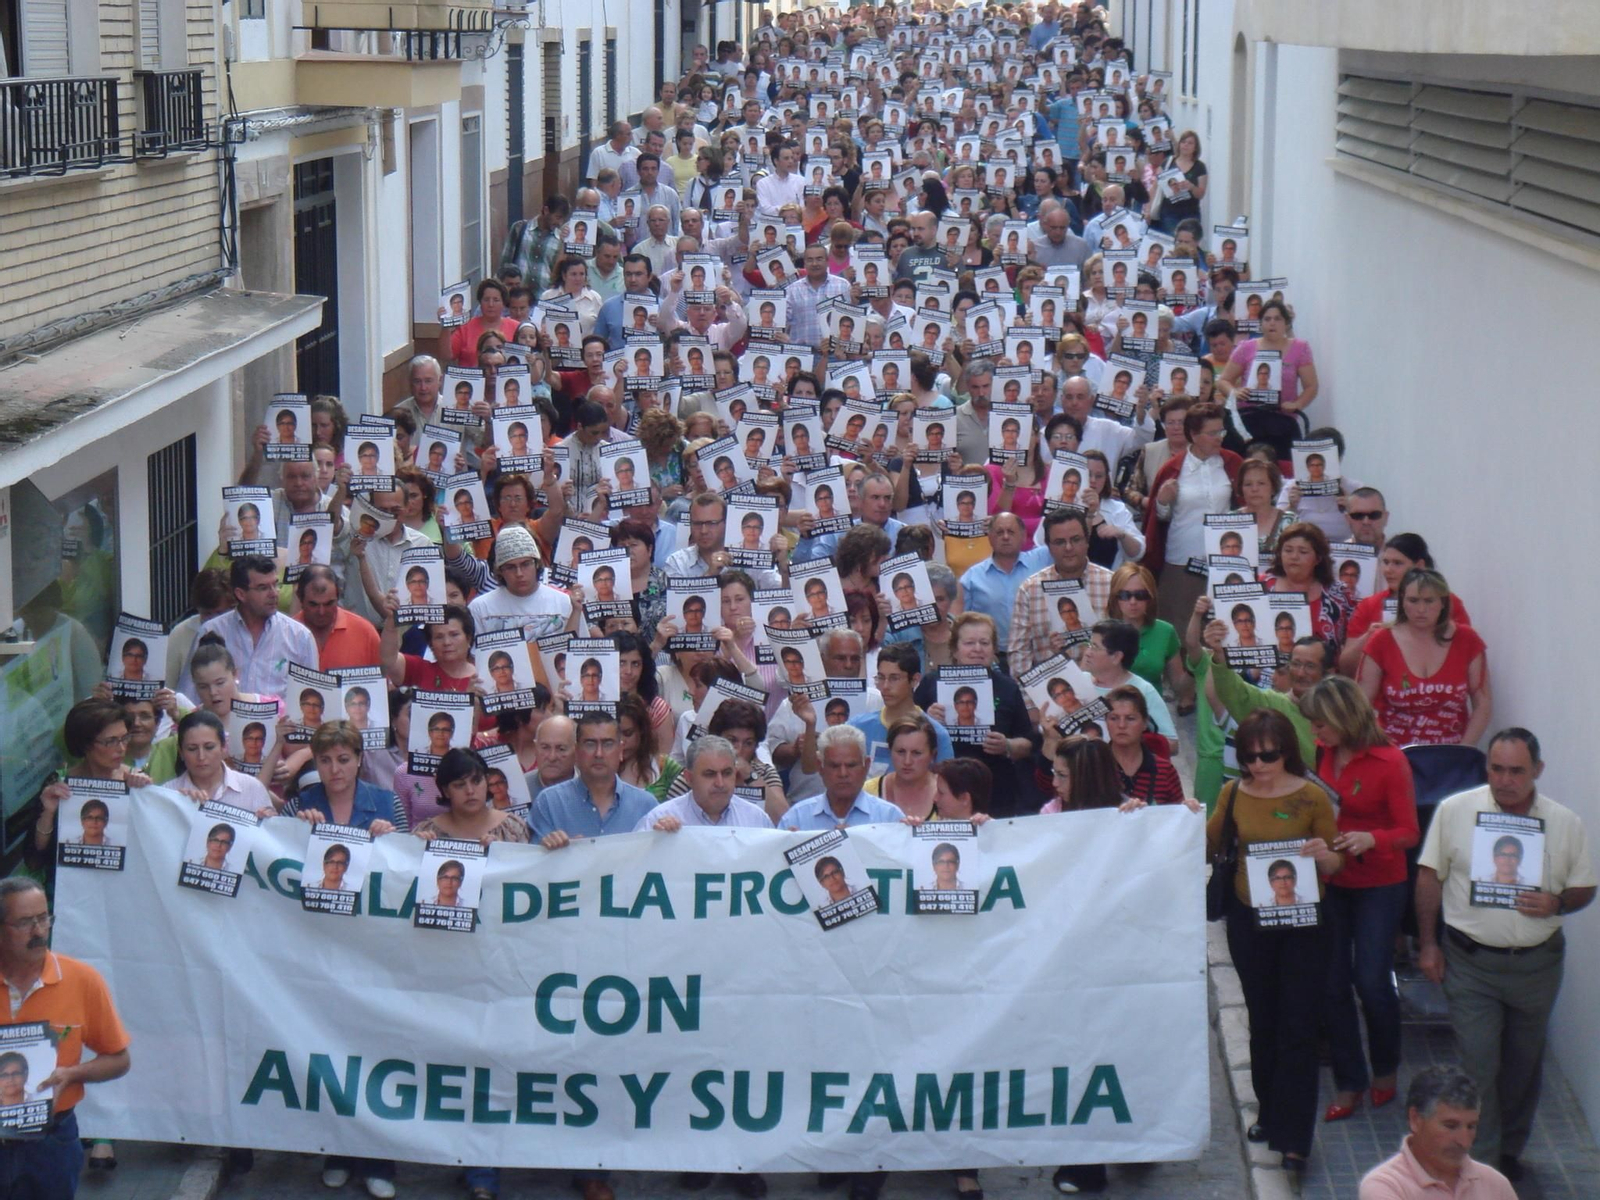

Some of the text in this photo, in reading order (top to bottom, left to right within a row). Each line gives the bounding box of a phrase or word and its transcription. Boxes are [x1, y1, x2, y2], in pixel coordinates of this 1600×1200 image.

[416, 691, 470, 702] DESAPARECIDA
[68, 778, 126, 791] DESAPARECIDA
[204, 801, 258, 823] DESAPARECIDA
[316, 823, 371, 838] DESAPARECIDA
[916, 823, 973, 833] DESAPARECIDA
[429, 839, 485, 853] DESAPARECIDA
[788, 829, 843, 860] DESAPARECIDA
[502, 881, 580, 923] DE
[600, 872, 676, 919] LA
[535, 972, 701, 1035] CON
[241, 1049, 1268, 1133] ANGELES Y SU FAMILIA
